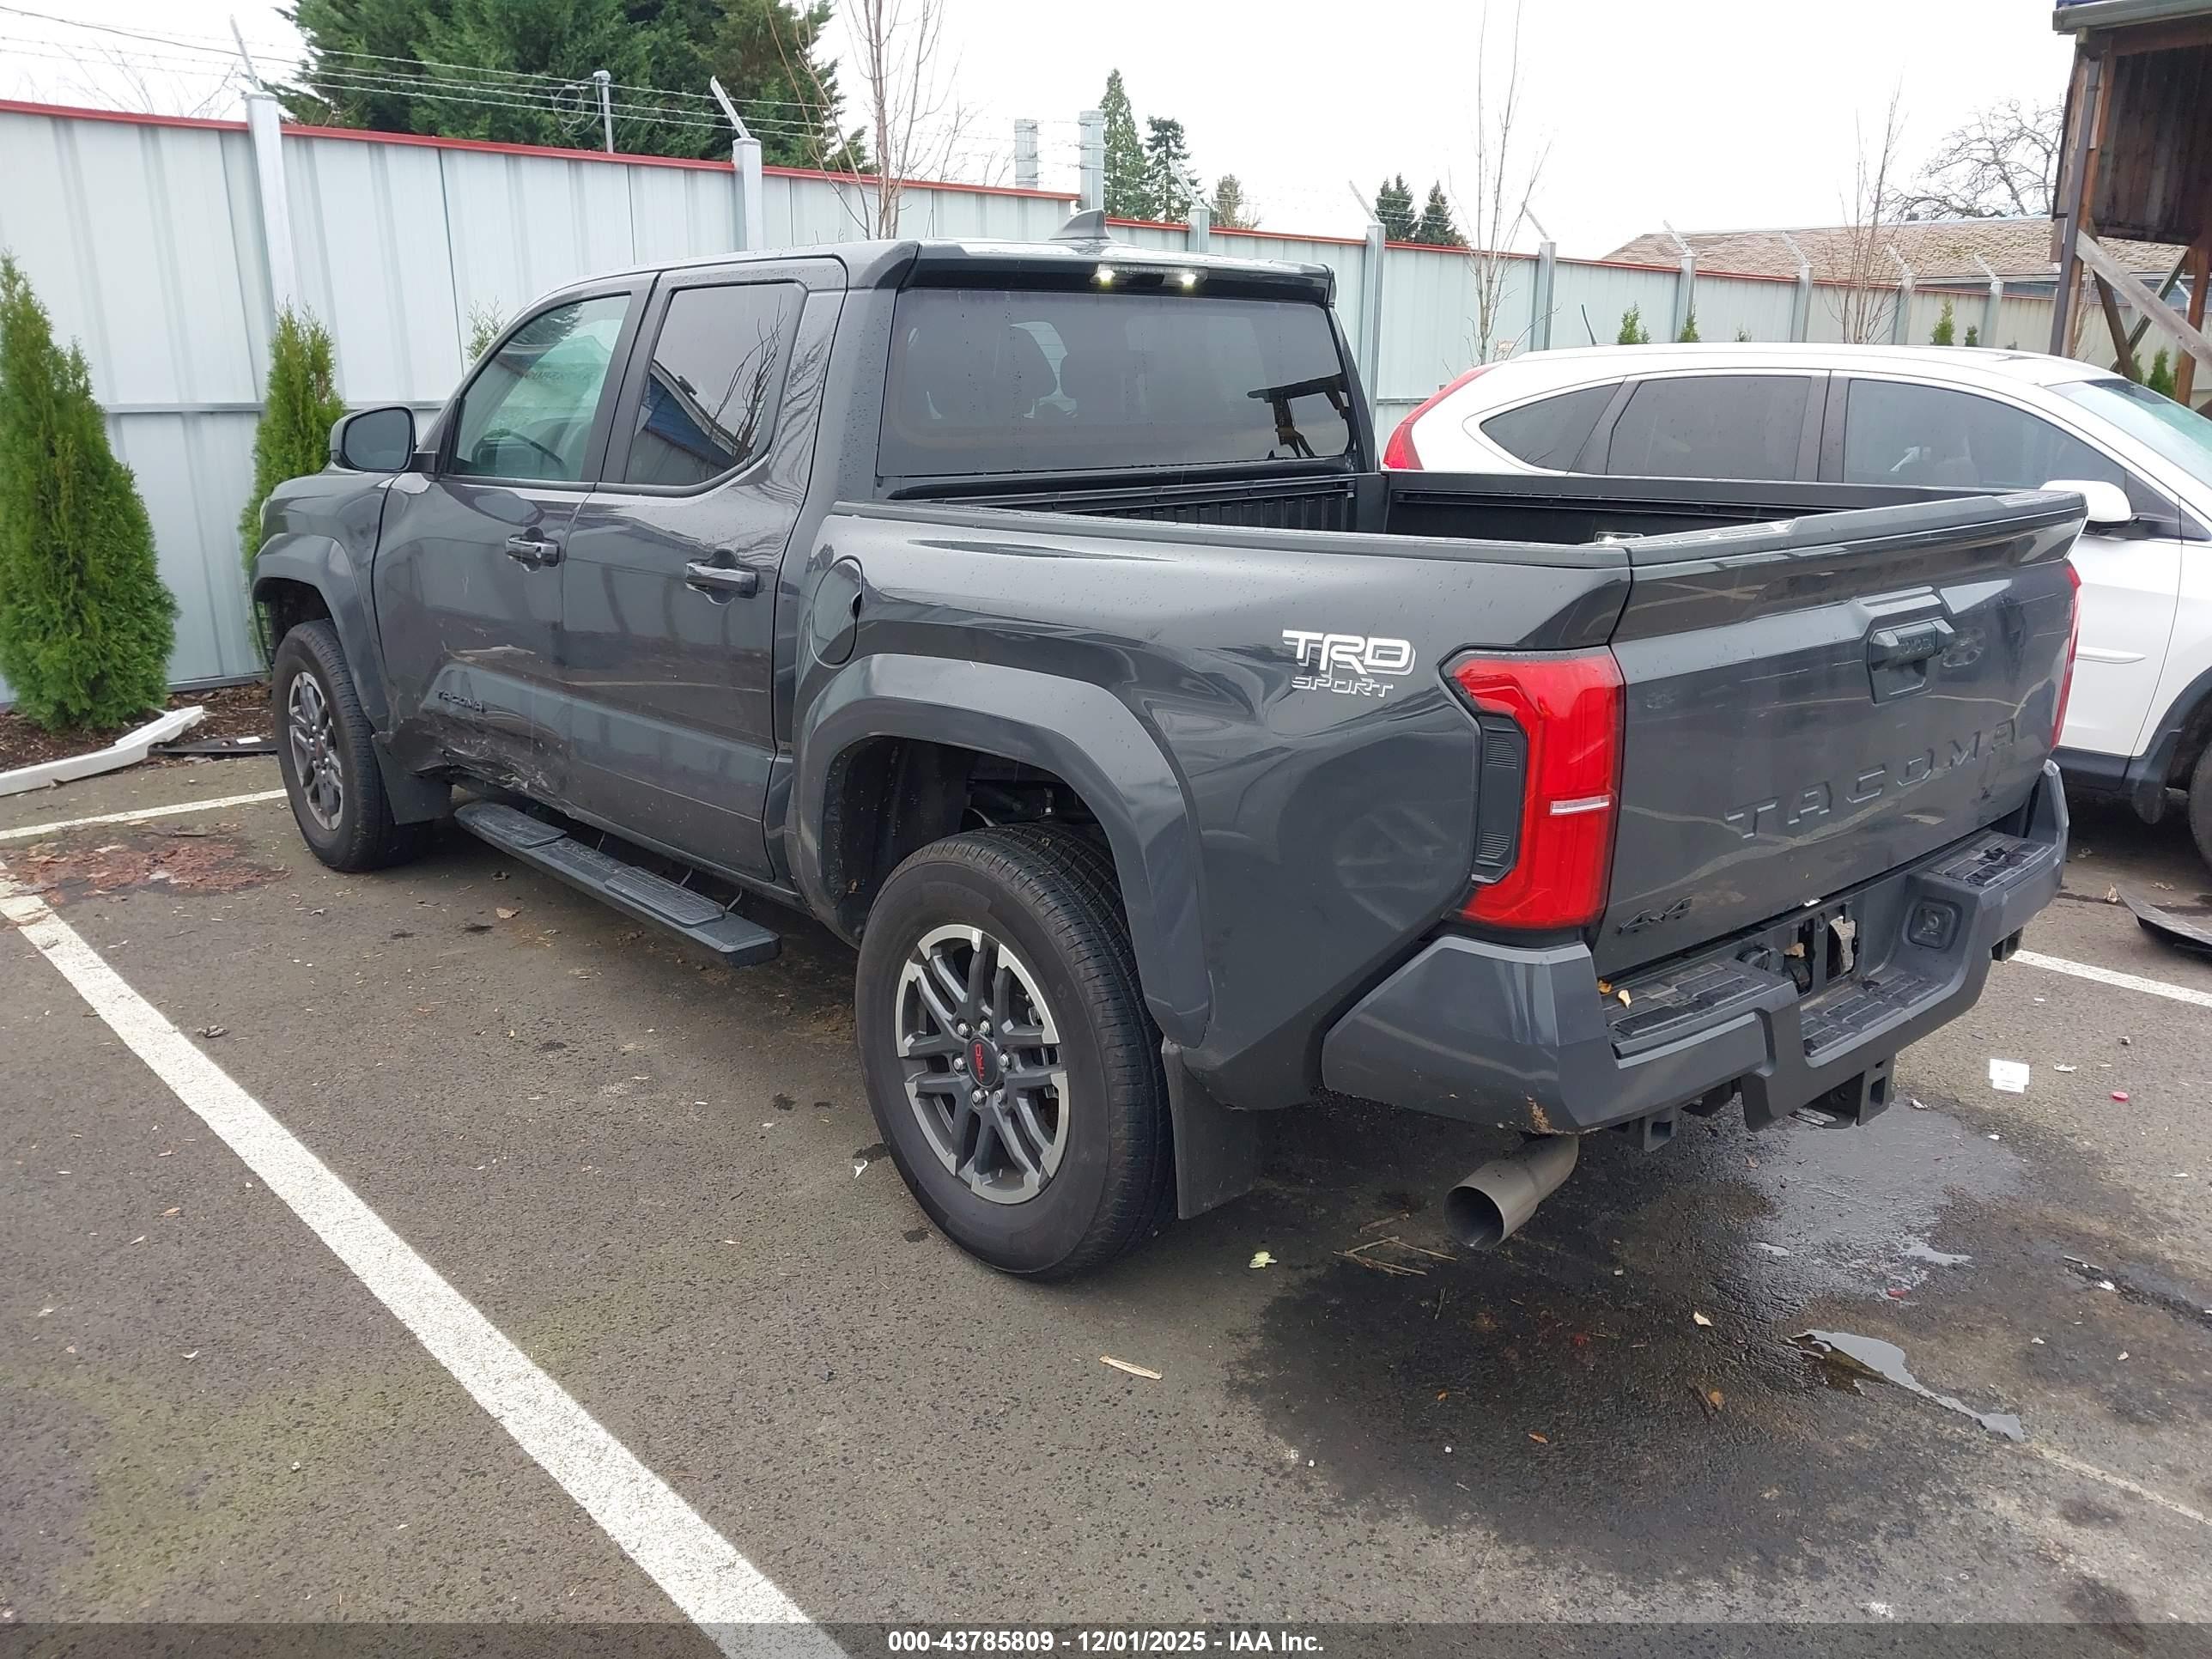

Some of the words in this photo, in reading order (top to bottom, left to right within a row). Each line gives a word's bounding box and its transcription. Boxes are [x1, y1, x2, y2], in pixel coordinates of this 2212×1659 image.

[1282, 629, 1416, 678] TRD
[1291, 674, 1394, 697] SPORT
[1723, 717, 2014, 839] TACOMA
